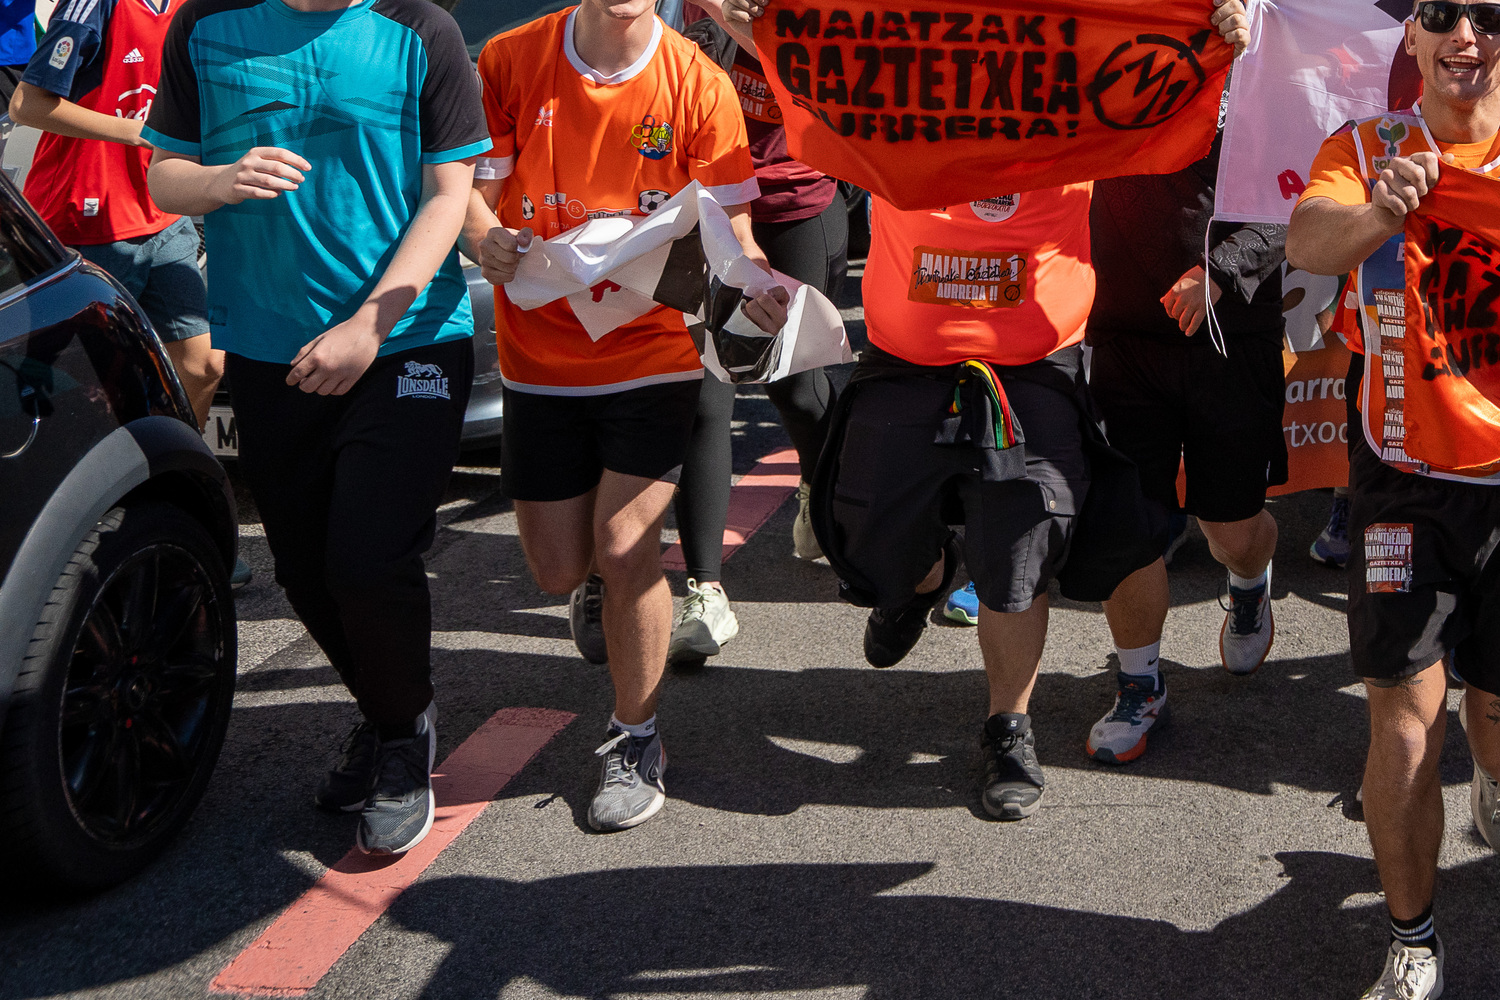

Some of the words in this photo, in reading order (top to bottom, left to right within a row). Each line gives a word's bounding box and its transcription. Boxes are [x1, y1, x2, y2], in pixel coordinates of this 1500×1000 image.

[775, 8, 1046, 45] MAIATZAK
[1060, 17, 1077, 46] 1
[776, 42, 1080, 114] GAZTETXEA
[921, 252, 1001, 282] MAIATZAK
[937, 283, 986, 300] AURRERA
[397, 376, 449, 398] LONSDALE
